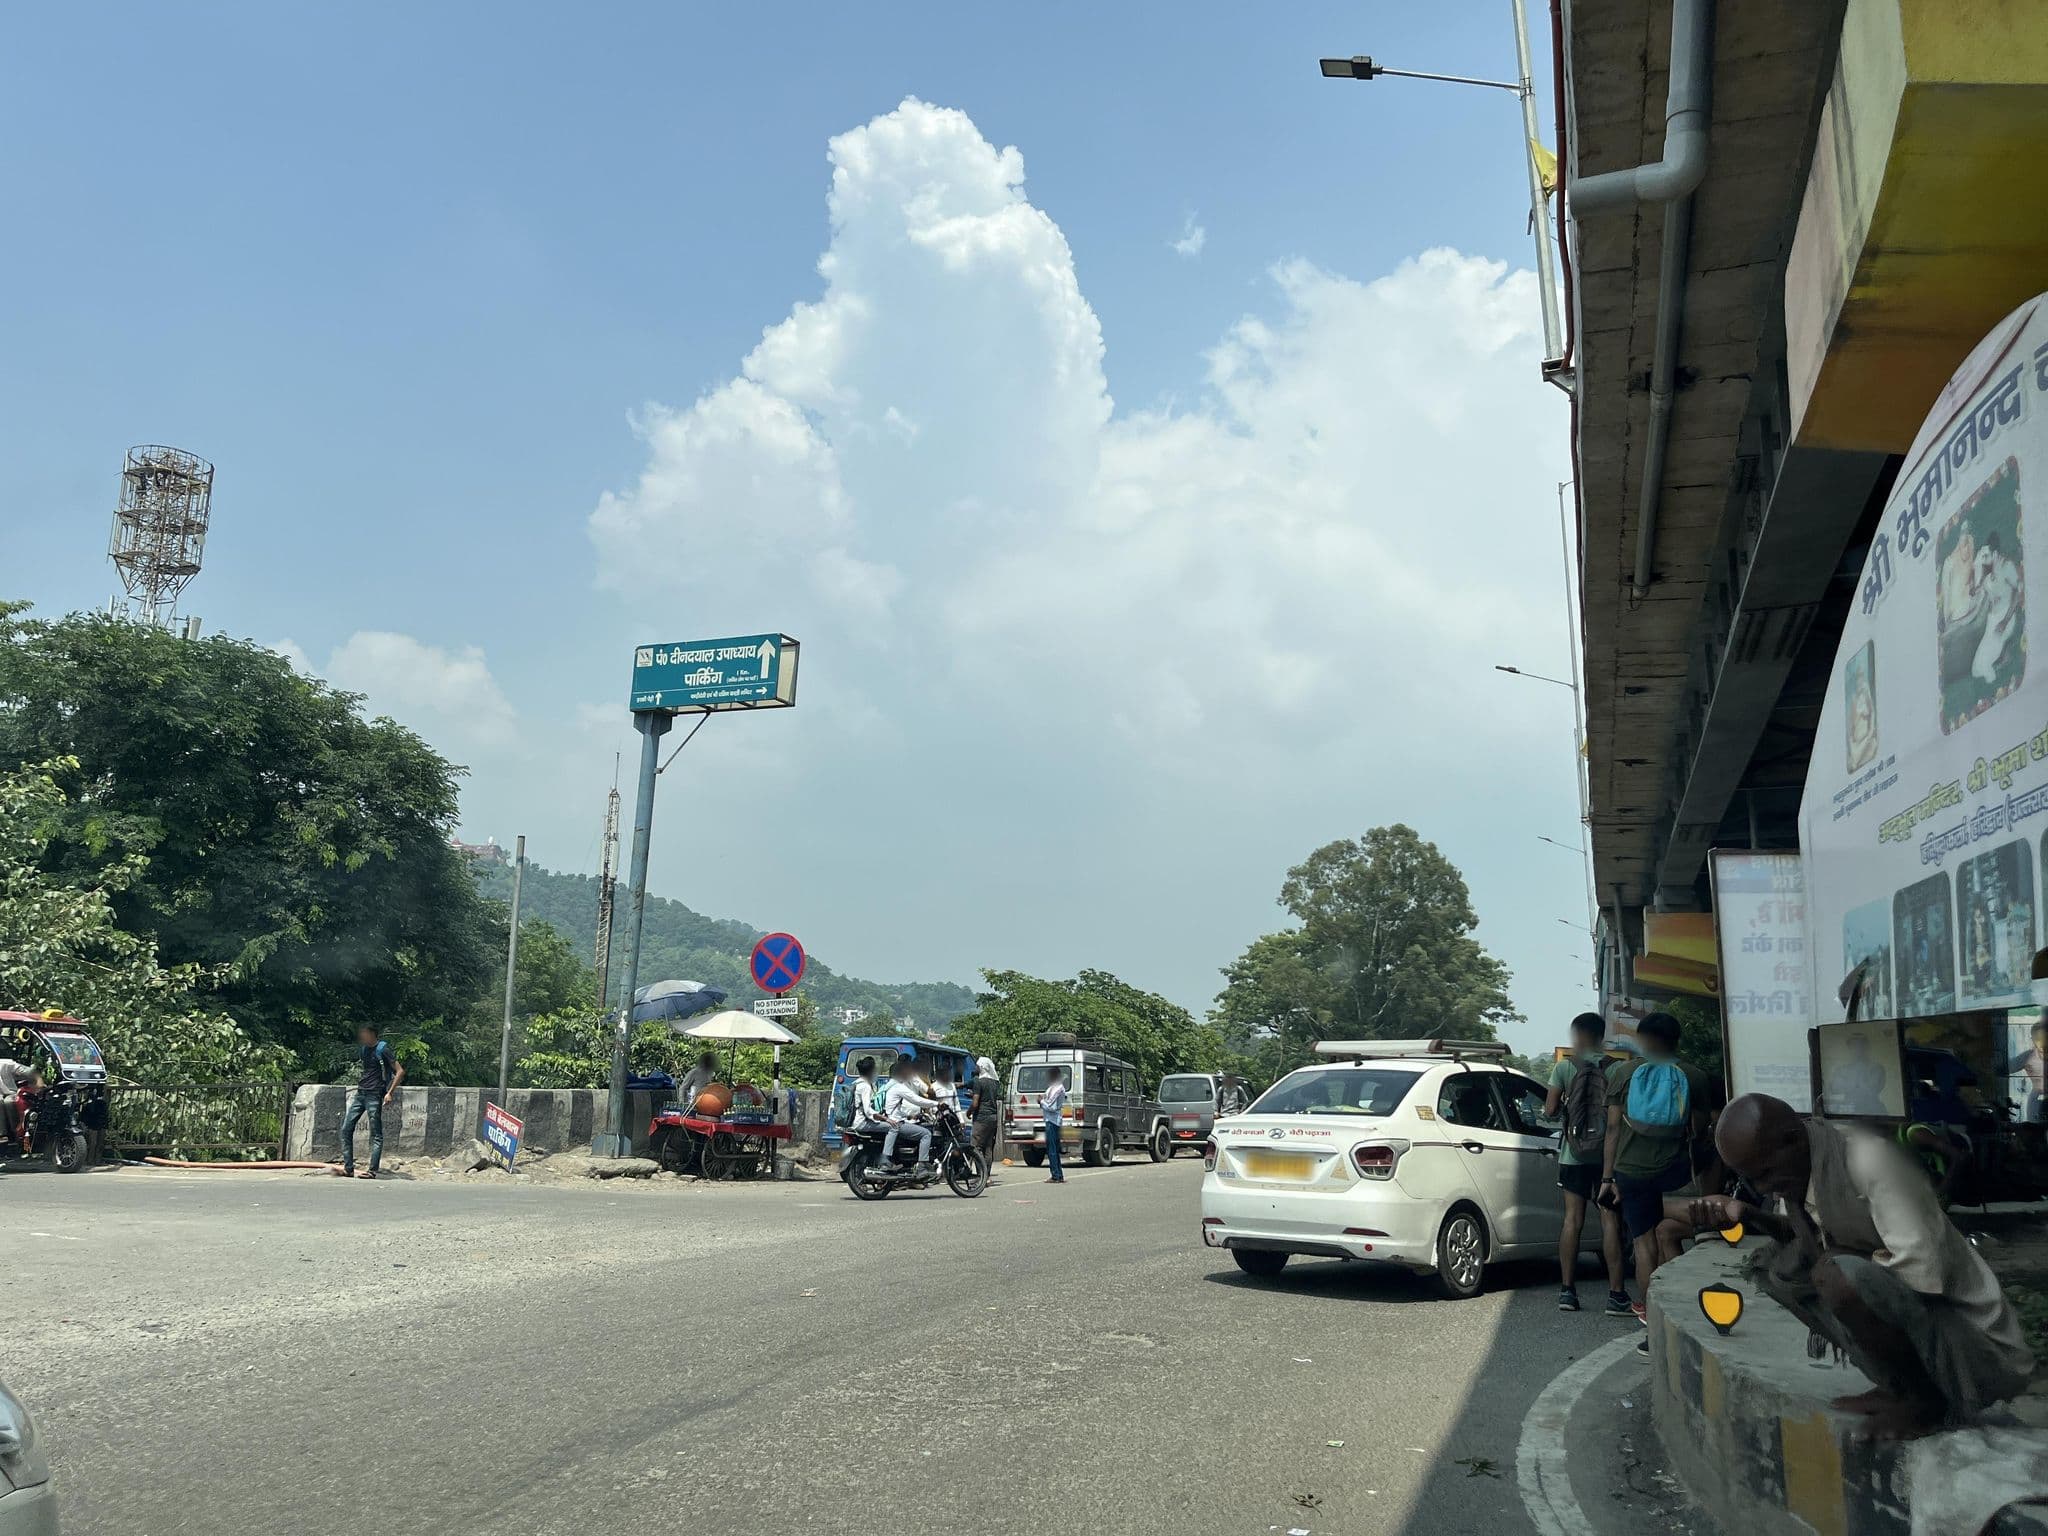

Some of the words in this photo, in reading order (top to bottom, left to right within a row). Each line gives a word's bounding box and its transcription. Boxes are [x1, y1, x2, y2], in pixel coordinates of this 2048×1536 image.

[1862, 533, 1890, 615] श्री
[1897, 362, 2024, 558] भूमानन्द
[656, 649, 668, 666] पं०
[670, 647, 715, 665] दीनदयाल
[716, 645, 757, 661] उपाध्याय
[684, 667, 723, 687] पार्किंग
[1966, 757, 1988, 794] श्री
[766, 999, 796, 1007] STOPPING
[488, 1125, 511, 1153] पार्किंग
